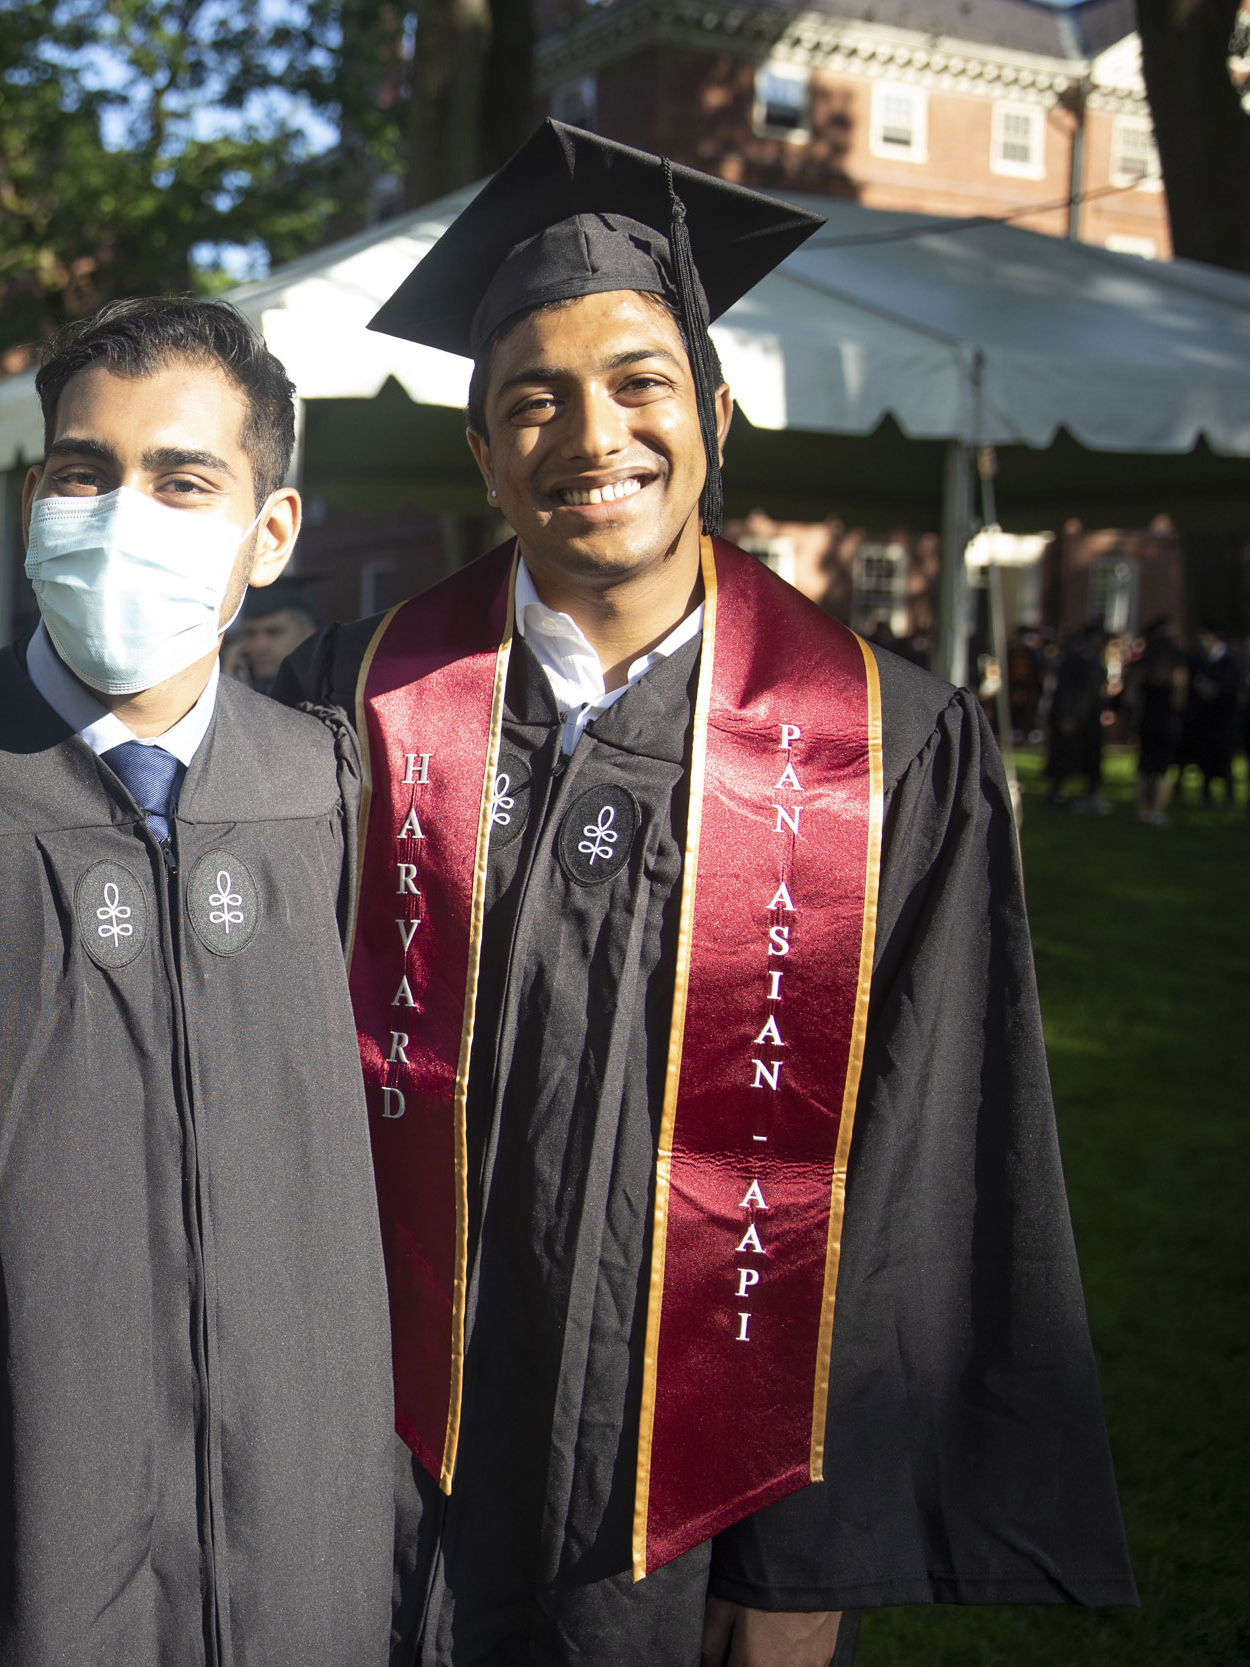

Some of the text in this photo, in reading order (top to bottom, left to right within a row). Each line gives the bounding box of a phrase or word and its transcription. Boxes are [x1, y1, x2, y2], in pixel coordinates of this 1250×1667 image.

[772, 723, 804, 835] PAN
[381, 753, 432, 1120] HARVARD
[751, 881, 796, 1091] ASIAN
[735, 1178, 769, 1342] AAPI
